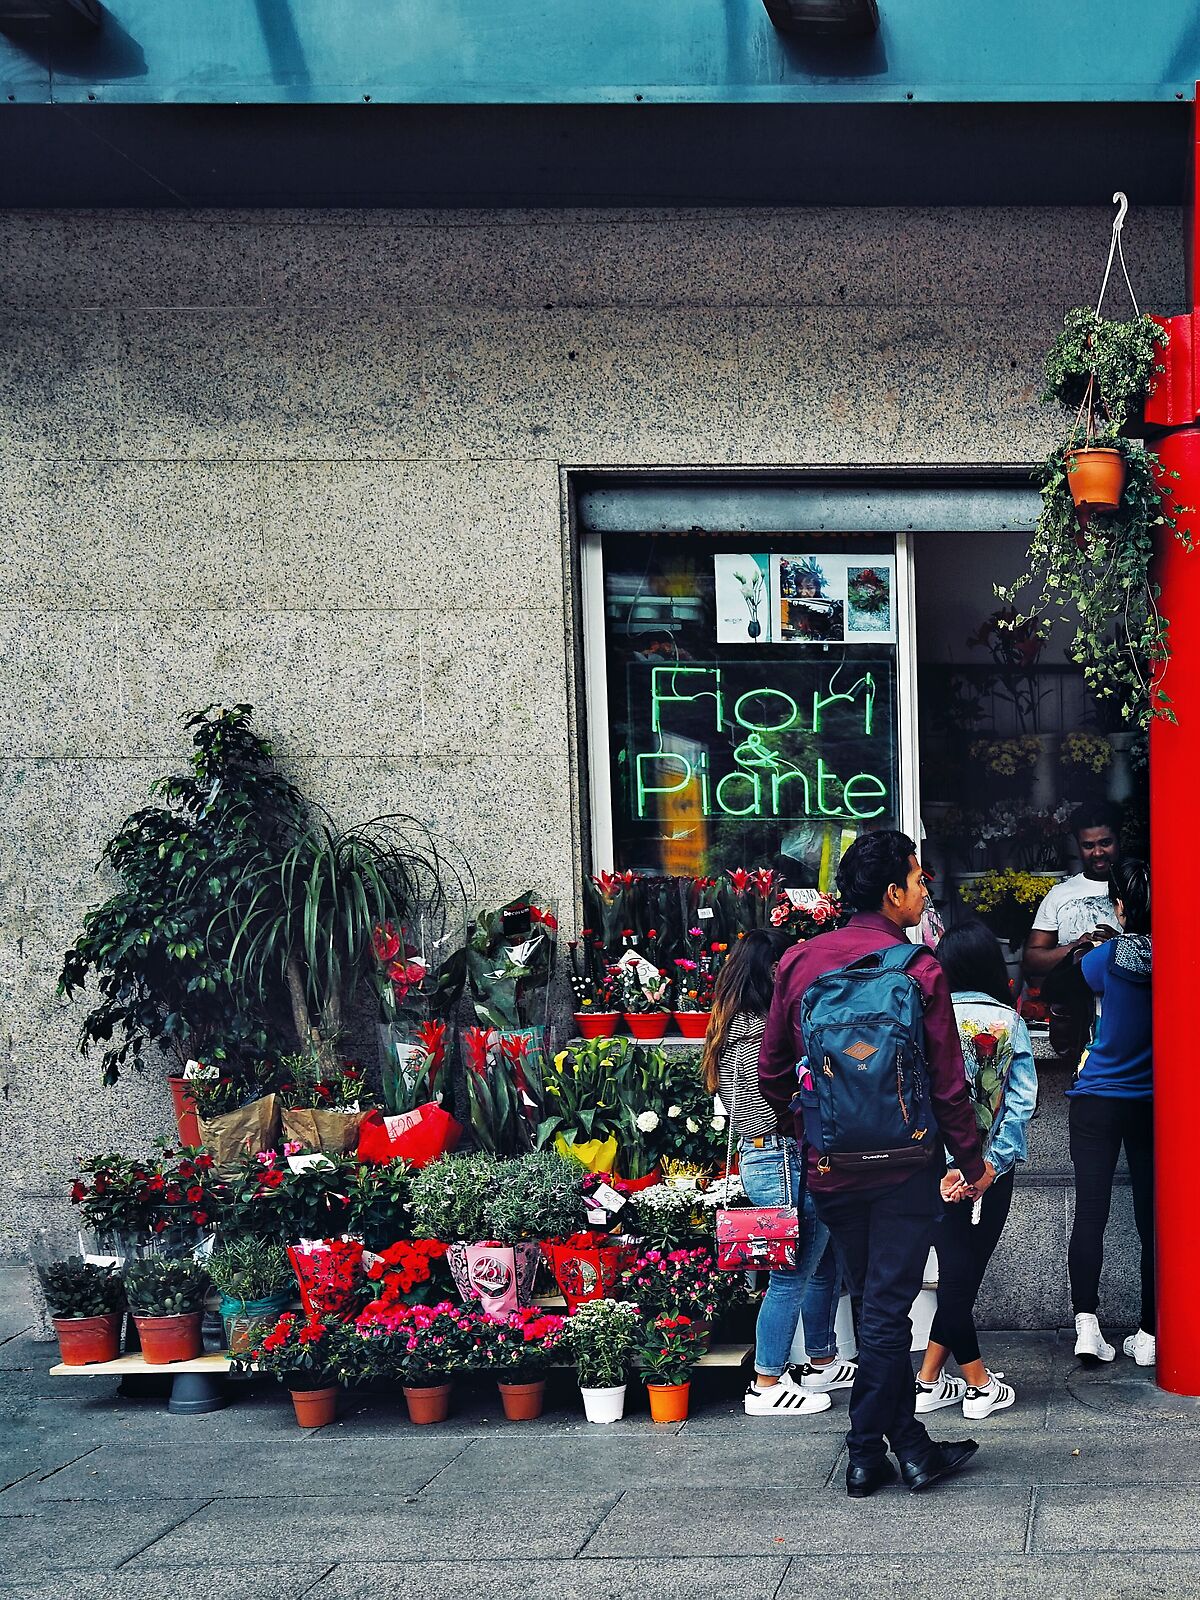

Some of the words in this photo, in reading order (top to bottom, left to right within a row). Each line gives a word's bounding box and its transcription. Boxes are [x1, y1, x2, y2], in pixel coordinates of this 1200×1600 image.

[651, 667, 874, 735] Fiori
[733, 733, 780, 767] &
[636, 751, 888, 819] Piante
